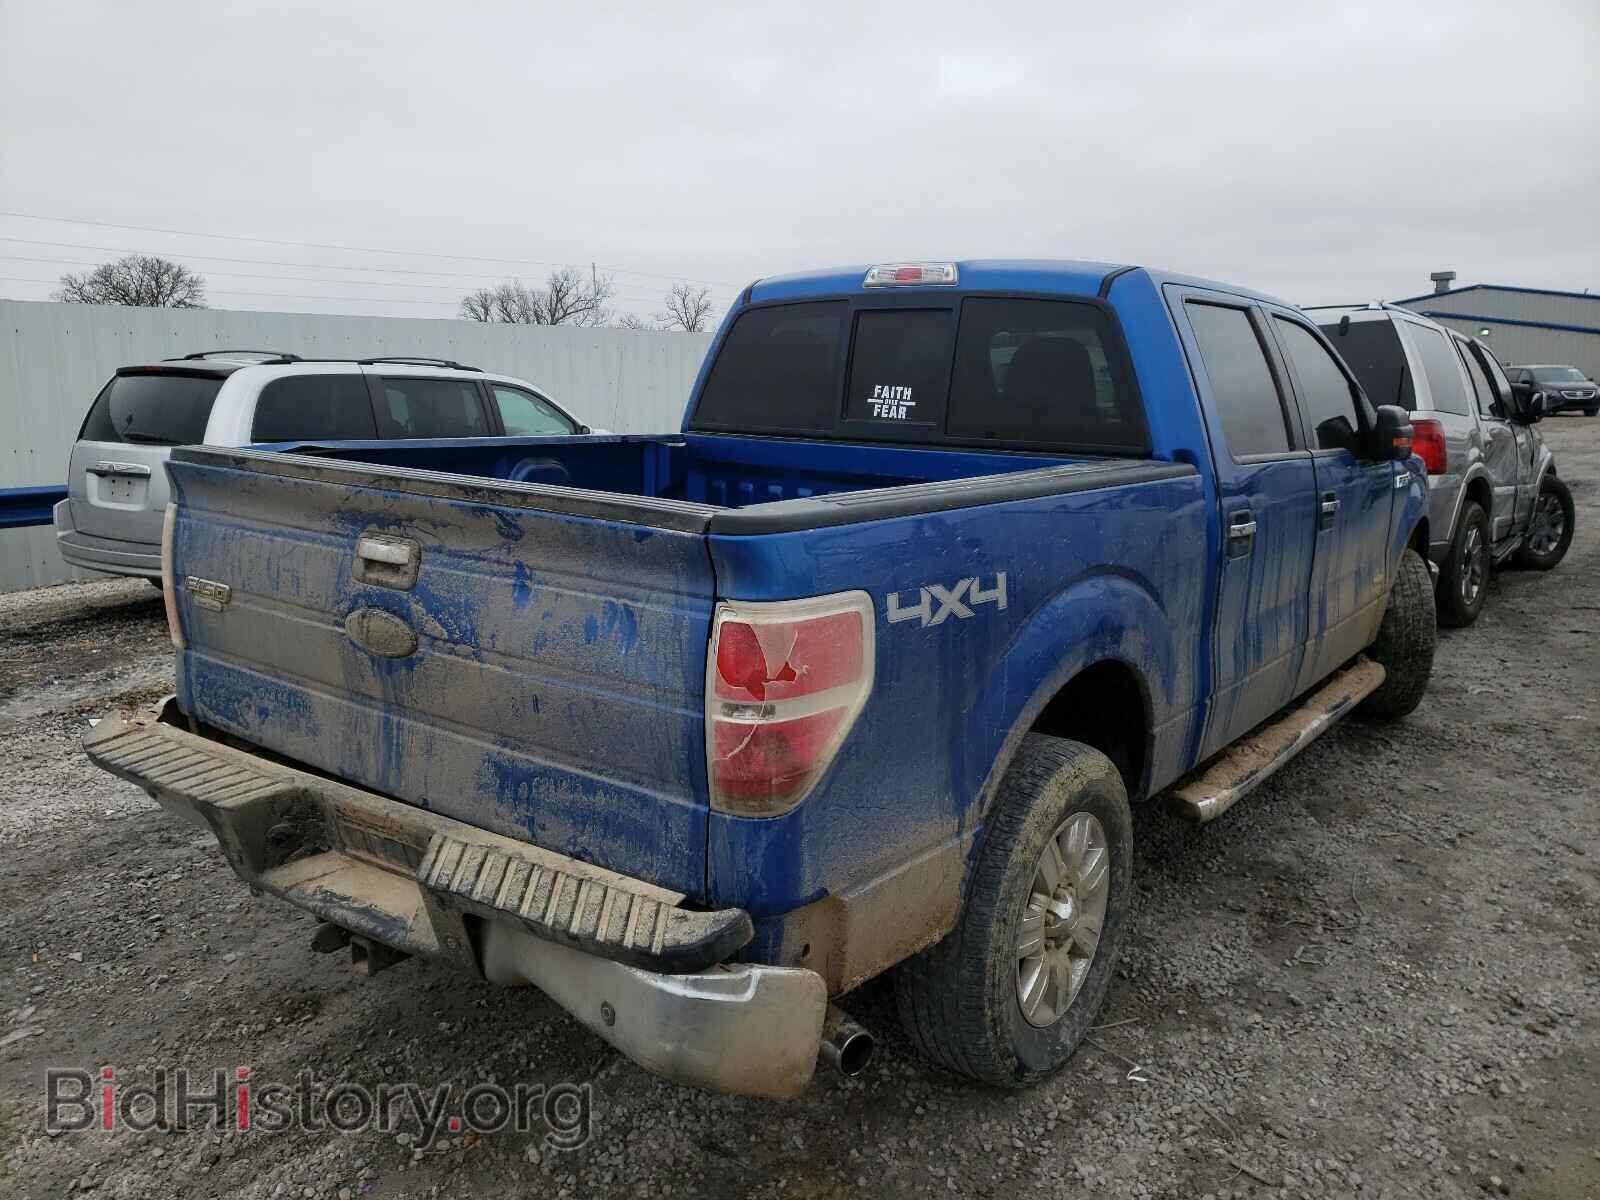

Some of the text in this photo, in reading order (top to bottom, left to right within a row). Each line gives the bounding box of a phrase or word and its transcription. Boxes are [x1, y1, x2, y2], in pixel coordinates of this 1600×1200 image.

[874, 384, 912, 400] FAITH
[873, 403, 907, 419] FEAR
[887, 571, 1008, 628] 4X4
